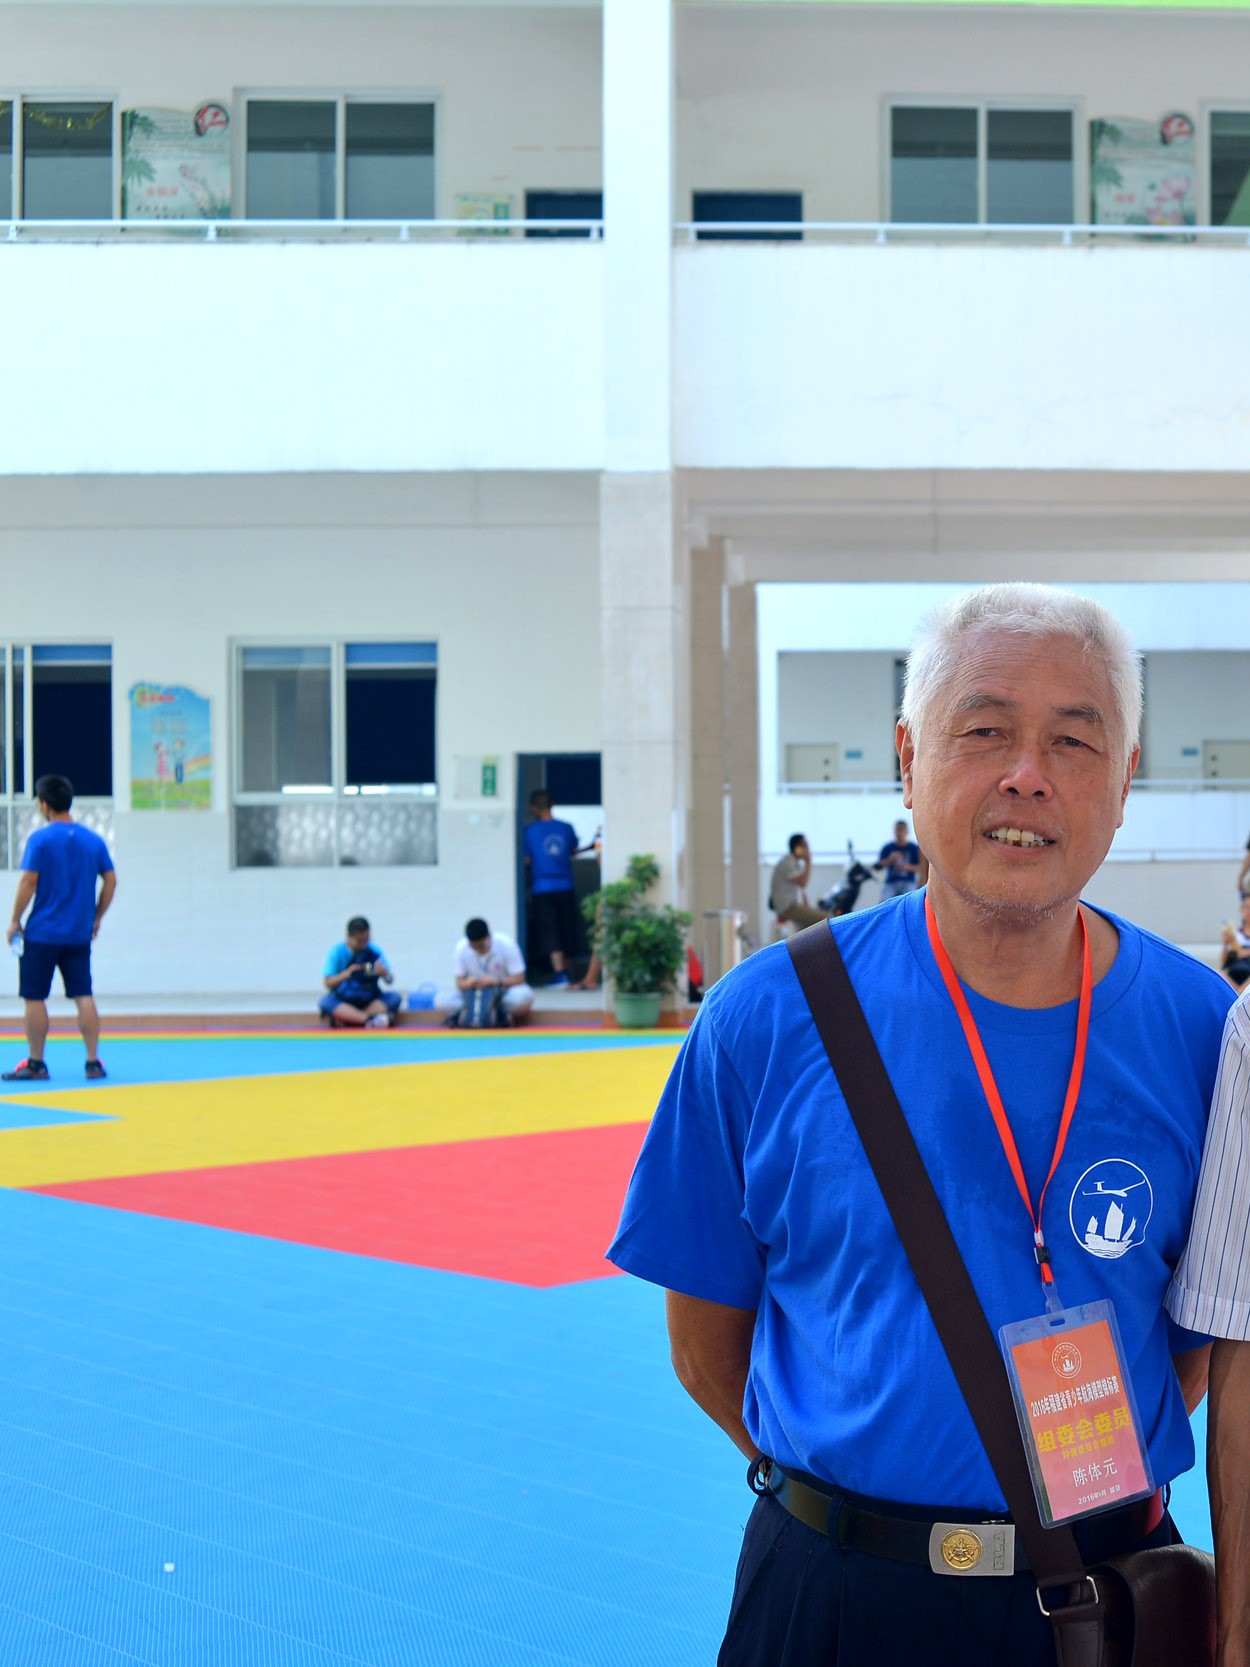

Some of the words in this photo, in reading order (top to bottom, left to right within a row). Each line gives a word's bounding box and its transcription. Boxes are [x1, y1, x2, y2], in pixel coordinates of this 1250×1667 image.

[1037, 1407, 1131, 1453] 组委会委员
[1073, 1458, 1118, 1487] 陈体元
